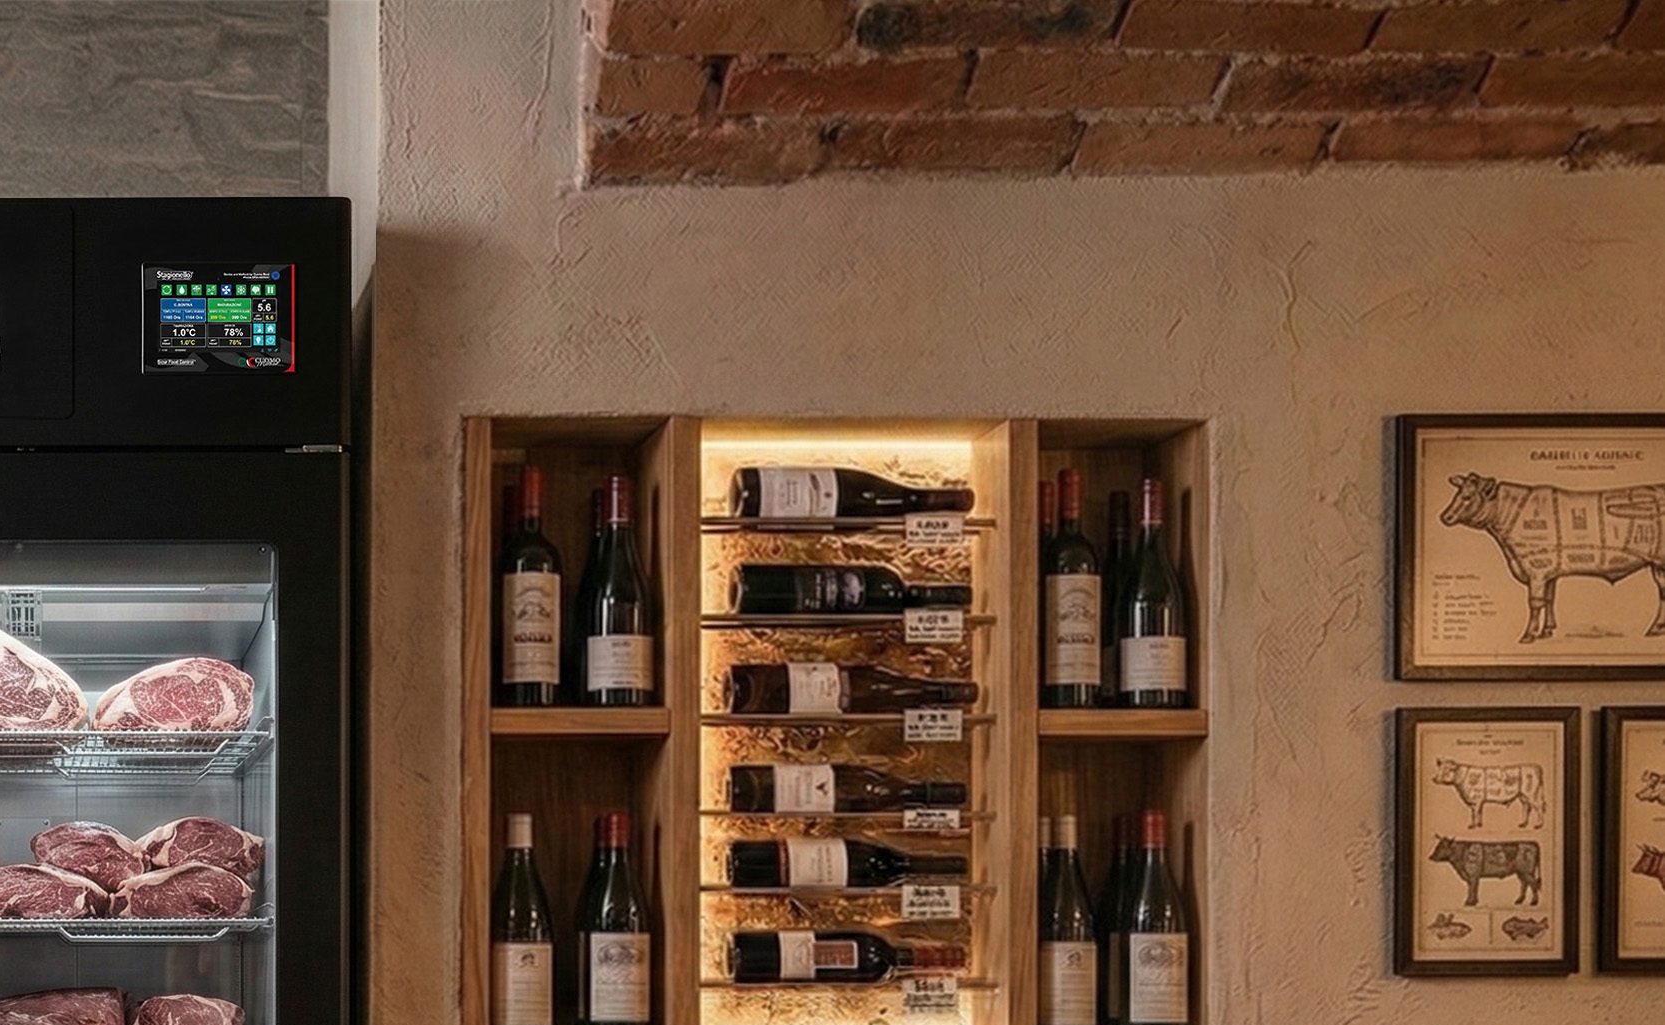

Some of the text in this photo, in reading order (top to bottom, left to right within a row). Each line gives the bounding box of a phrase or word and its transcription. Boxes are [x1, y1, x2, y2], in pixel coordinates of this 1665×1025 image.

[257, 303, 272, 312] 5.6
[172, 328, 196, 337] 1.0°C
[224, 328, 244, 337] 78%
